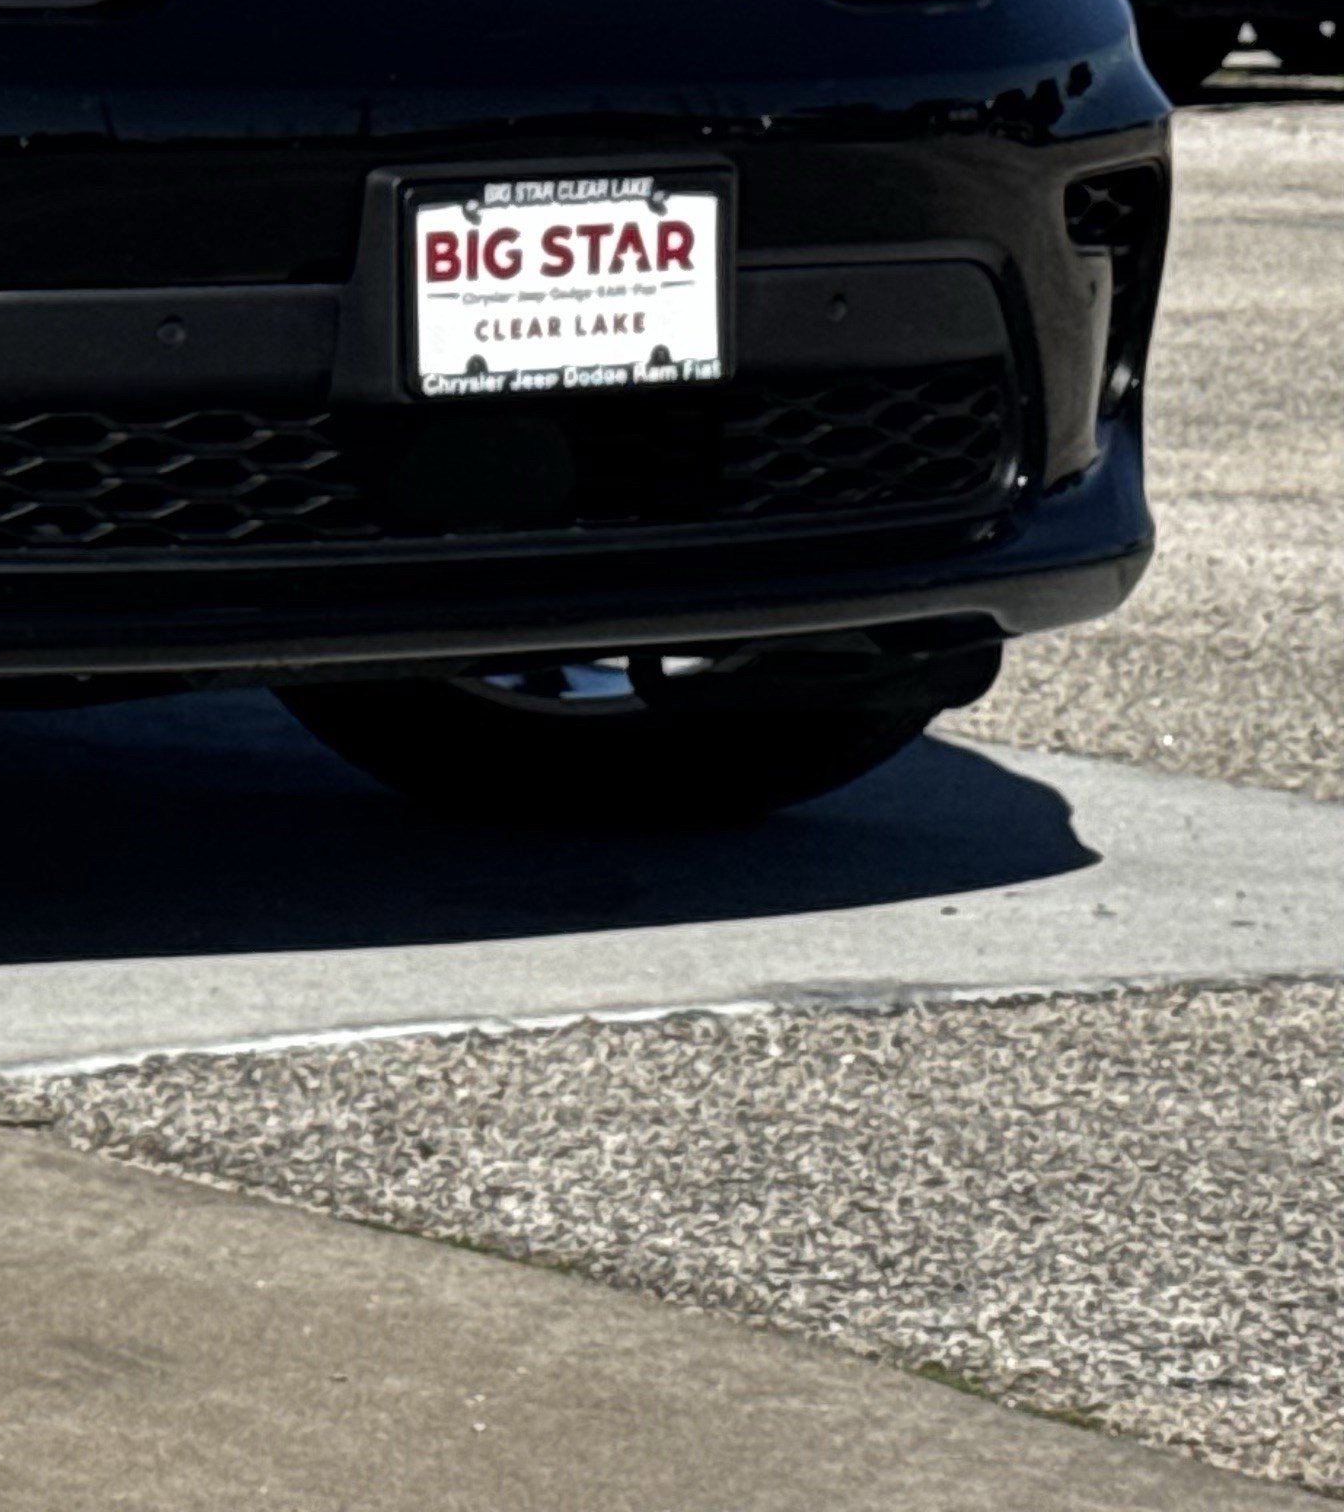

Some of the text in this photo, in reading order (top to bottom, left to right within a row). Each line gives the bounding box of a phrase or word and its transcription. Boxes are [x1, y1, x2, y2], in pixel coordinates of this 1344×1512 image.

[483, 176, 654, 205] BIG STAR CLEAR LAKE
[425, 220, 695, 284] BIG STAR
[474, 311, 646, 342] CLEAR LAKE
[422, 357, 721, 396] Chrysler Jeep Dodge Ram Fiat
